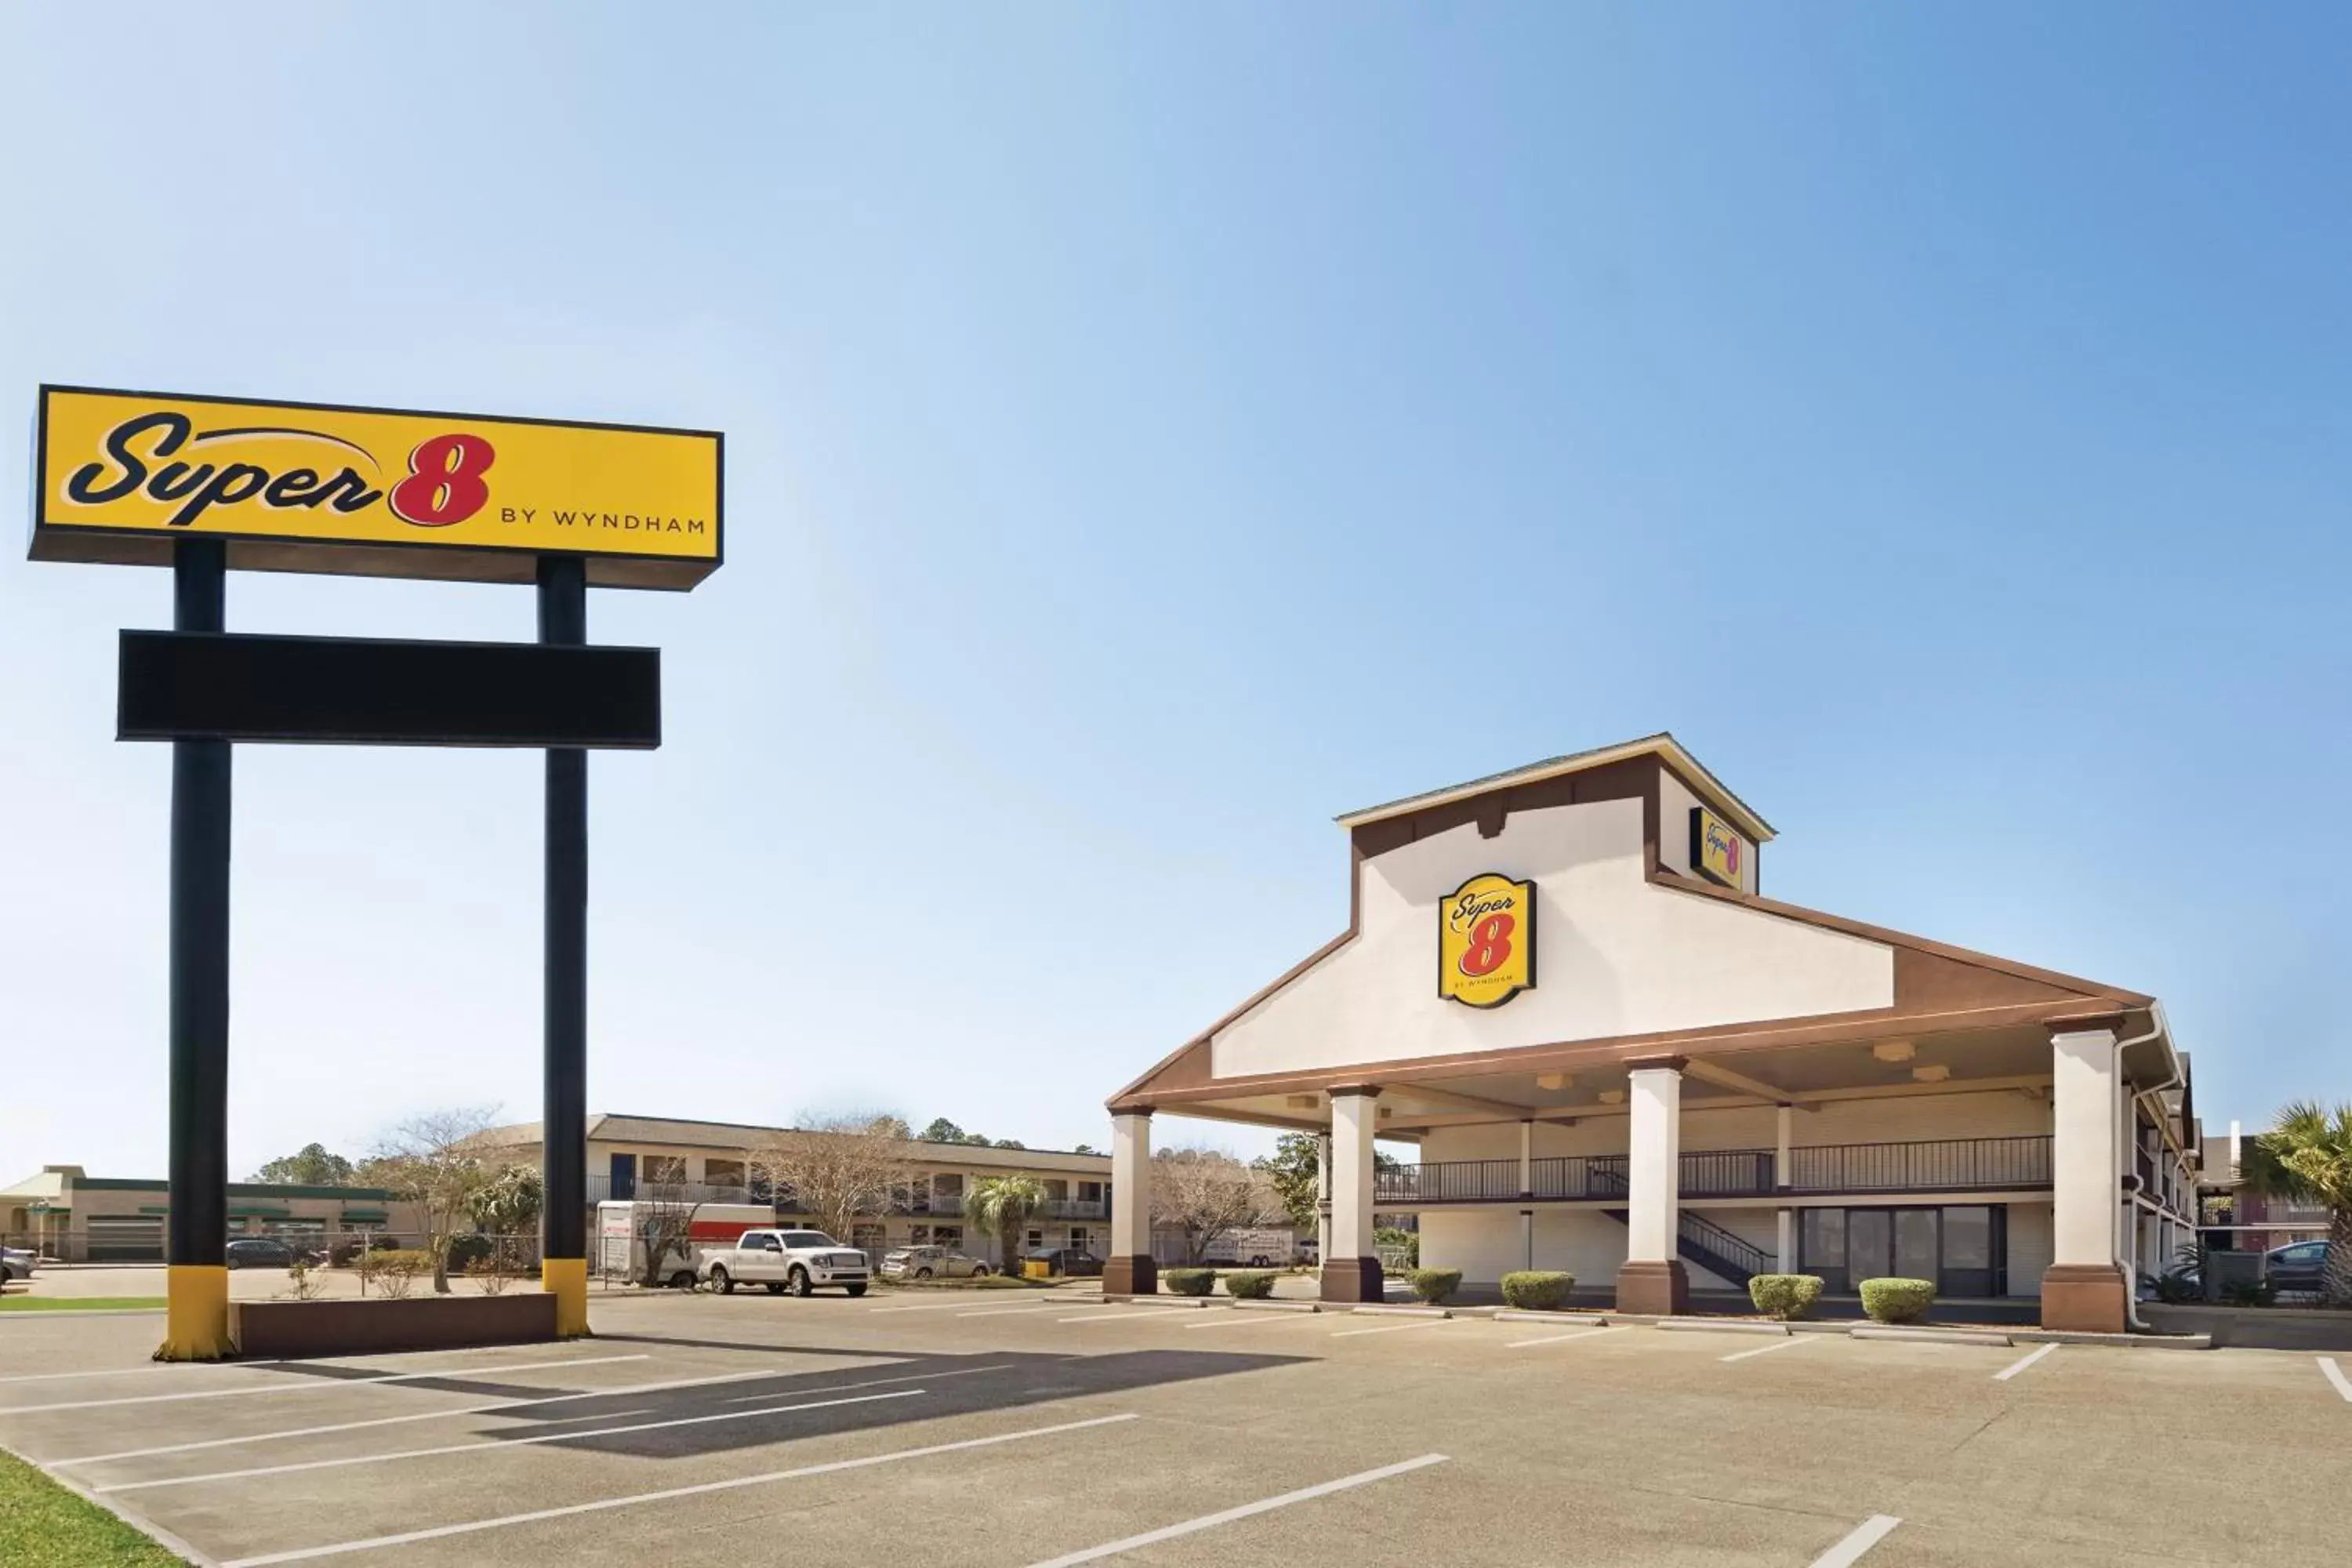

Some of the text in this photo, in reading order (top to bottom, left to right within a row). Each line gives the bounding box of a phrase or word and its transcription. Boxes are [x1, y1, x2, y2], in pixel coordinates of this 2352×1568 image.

[63, 411, 496, 528] Super 8
[501, 507, 705, 535] BY WYNDHAM
[1451, 891, 1516, 930] Super
[1458, 913, 1516, 978] 8
